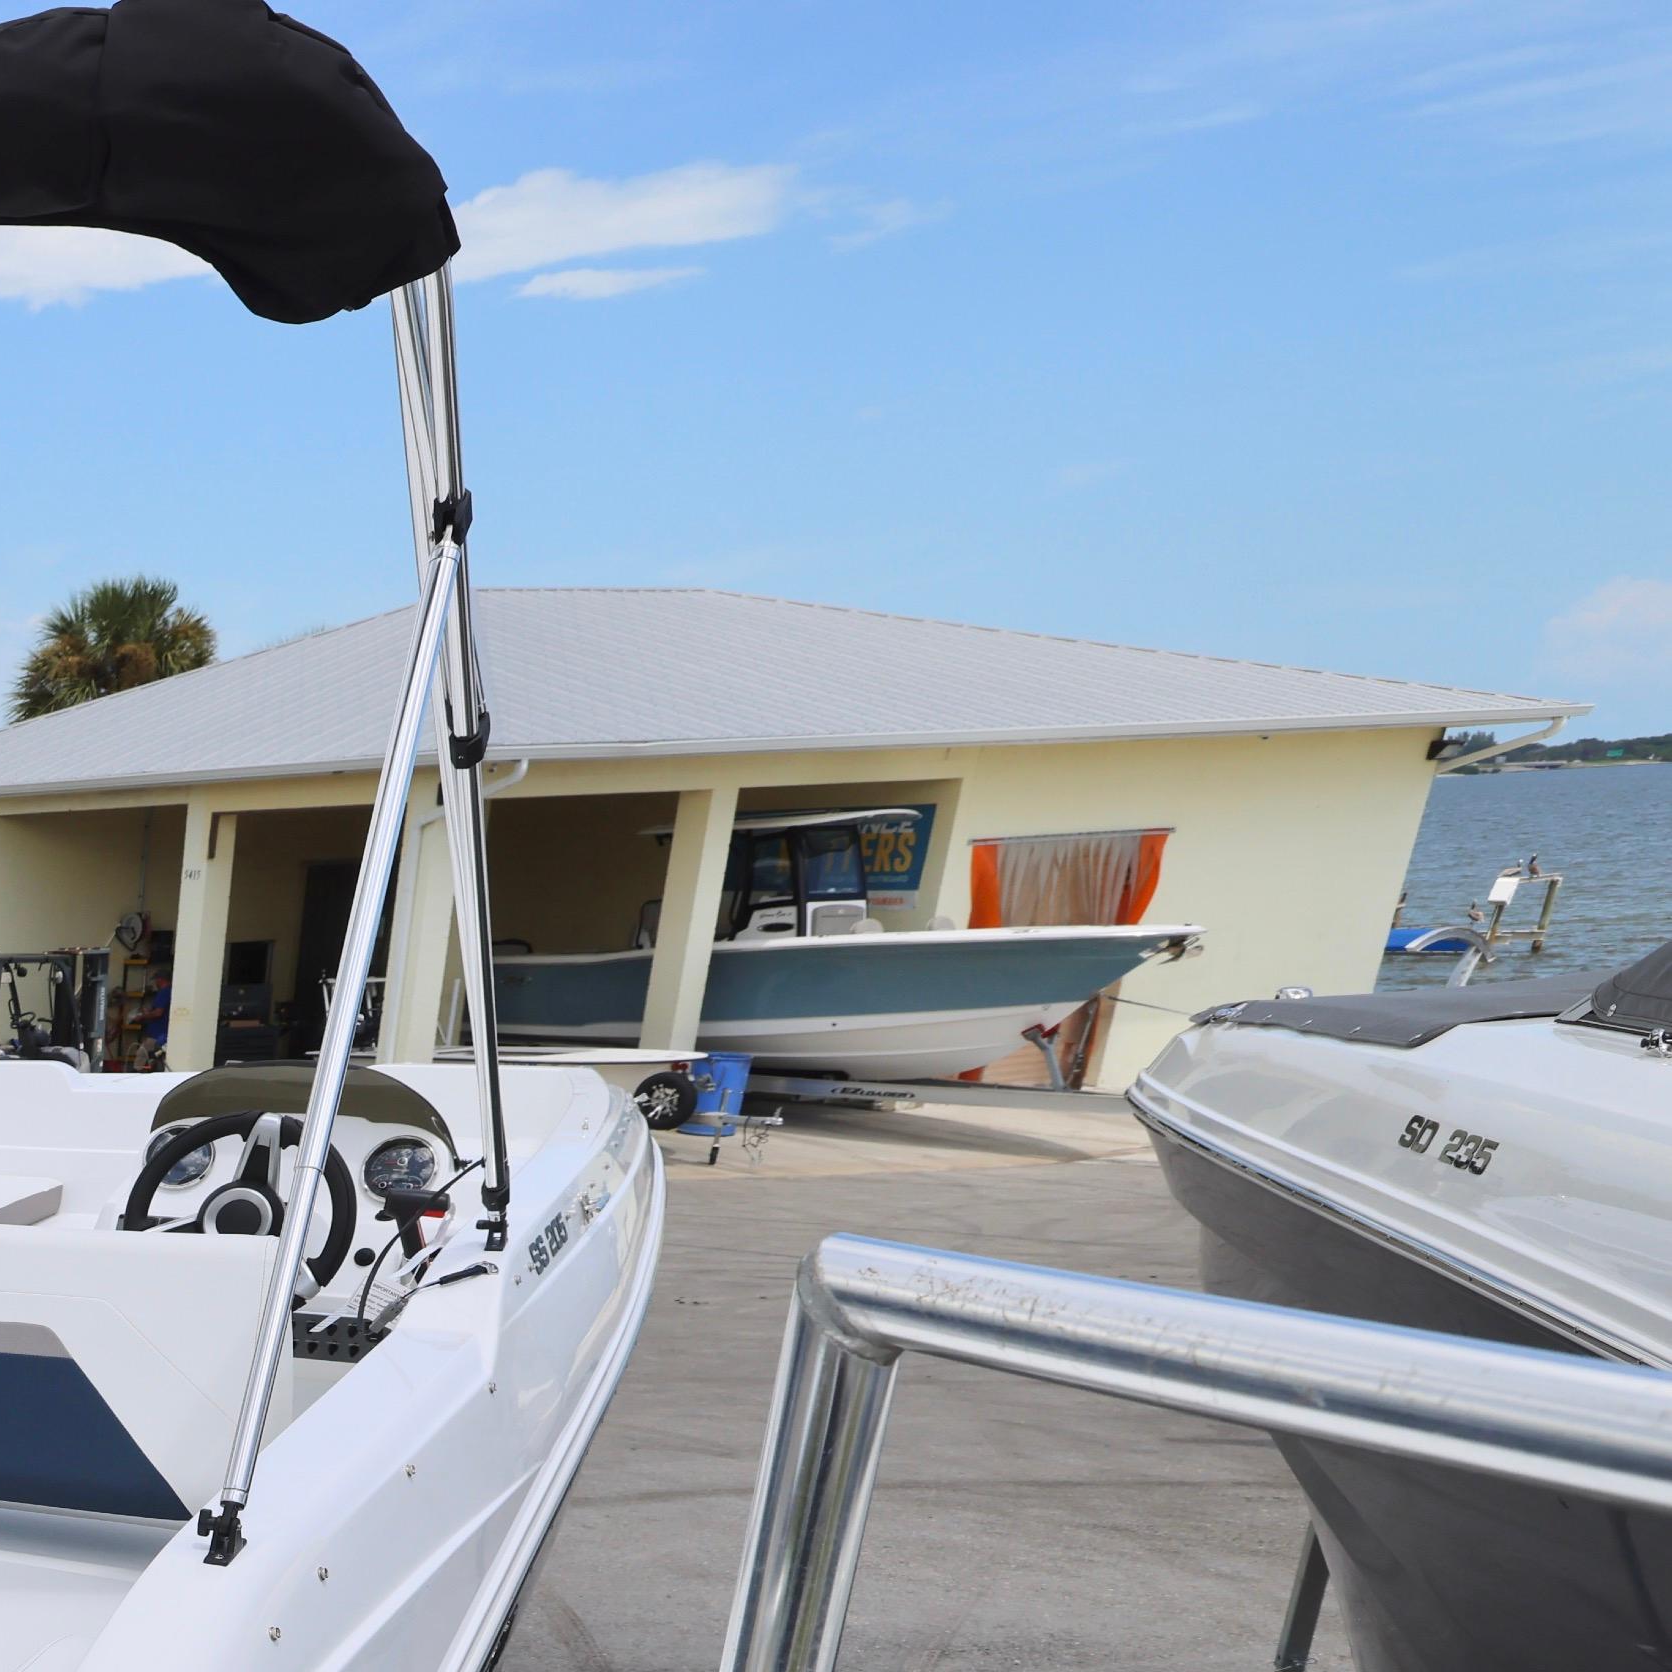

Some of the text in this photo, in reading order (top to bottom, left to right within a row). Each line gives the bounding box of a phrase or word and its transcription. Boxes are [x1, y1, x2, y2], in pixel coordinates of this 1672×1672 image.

[1438, 1128, 1500, 1176] 235
[528, 1211, 569, 1276] SS 205
